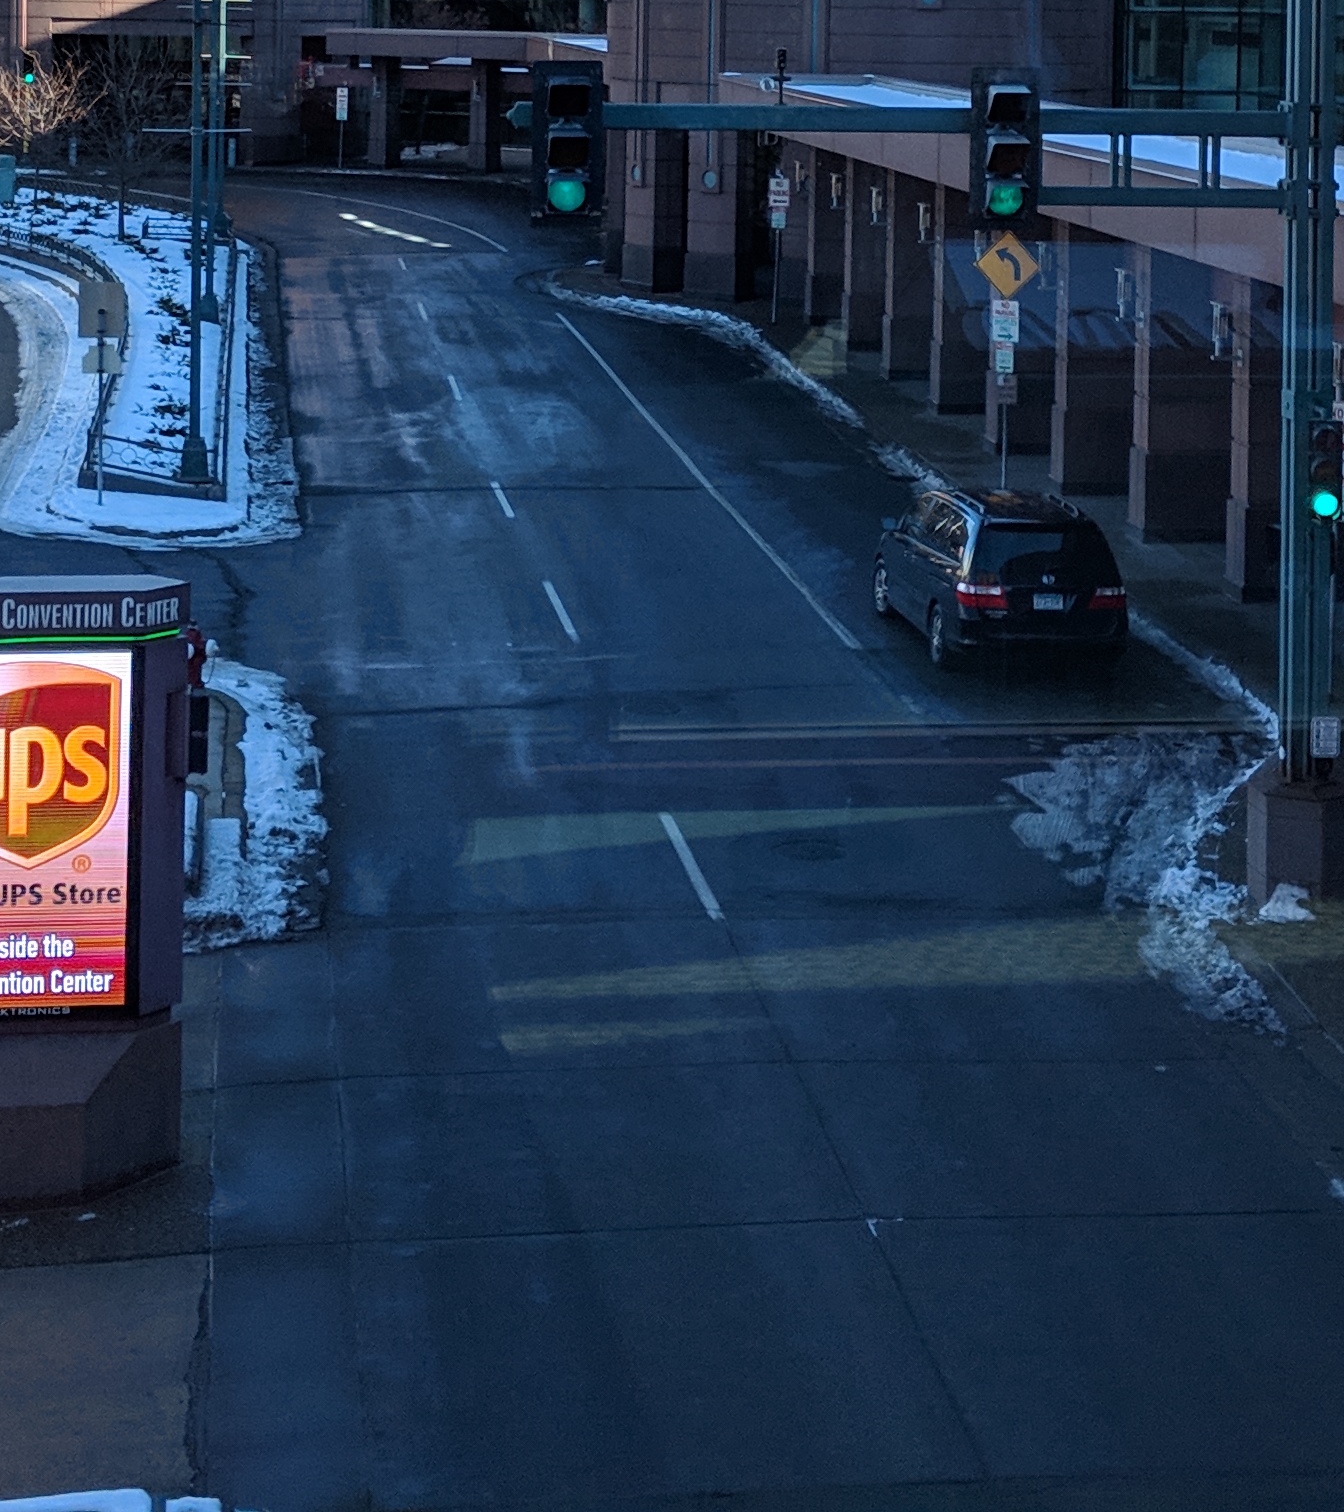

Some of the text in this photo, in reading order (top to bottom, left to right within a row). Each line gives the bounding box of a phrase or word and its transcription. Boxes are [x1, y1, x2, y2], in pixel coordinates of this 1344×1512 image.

[53, 882, 122, 905] Store
[43, 933, 74, 958] the
[50, 969, 115, 994] Center
